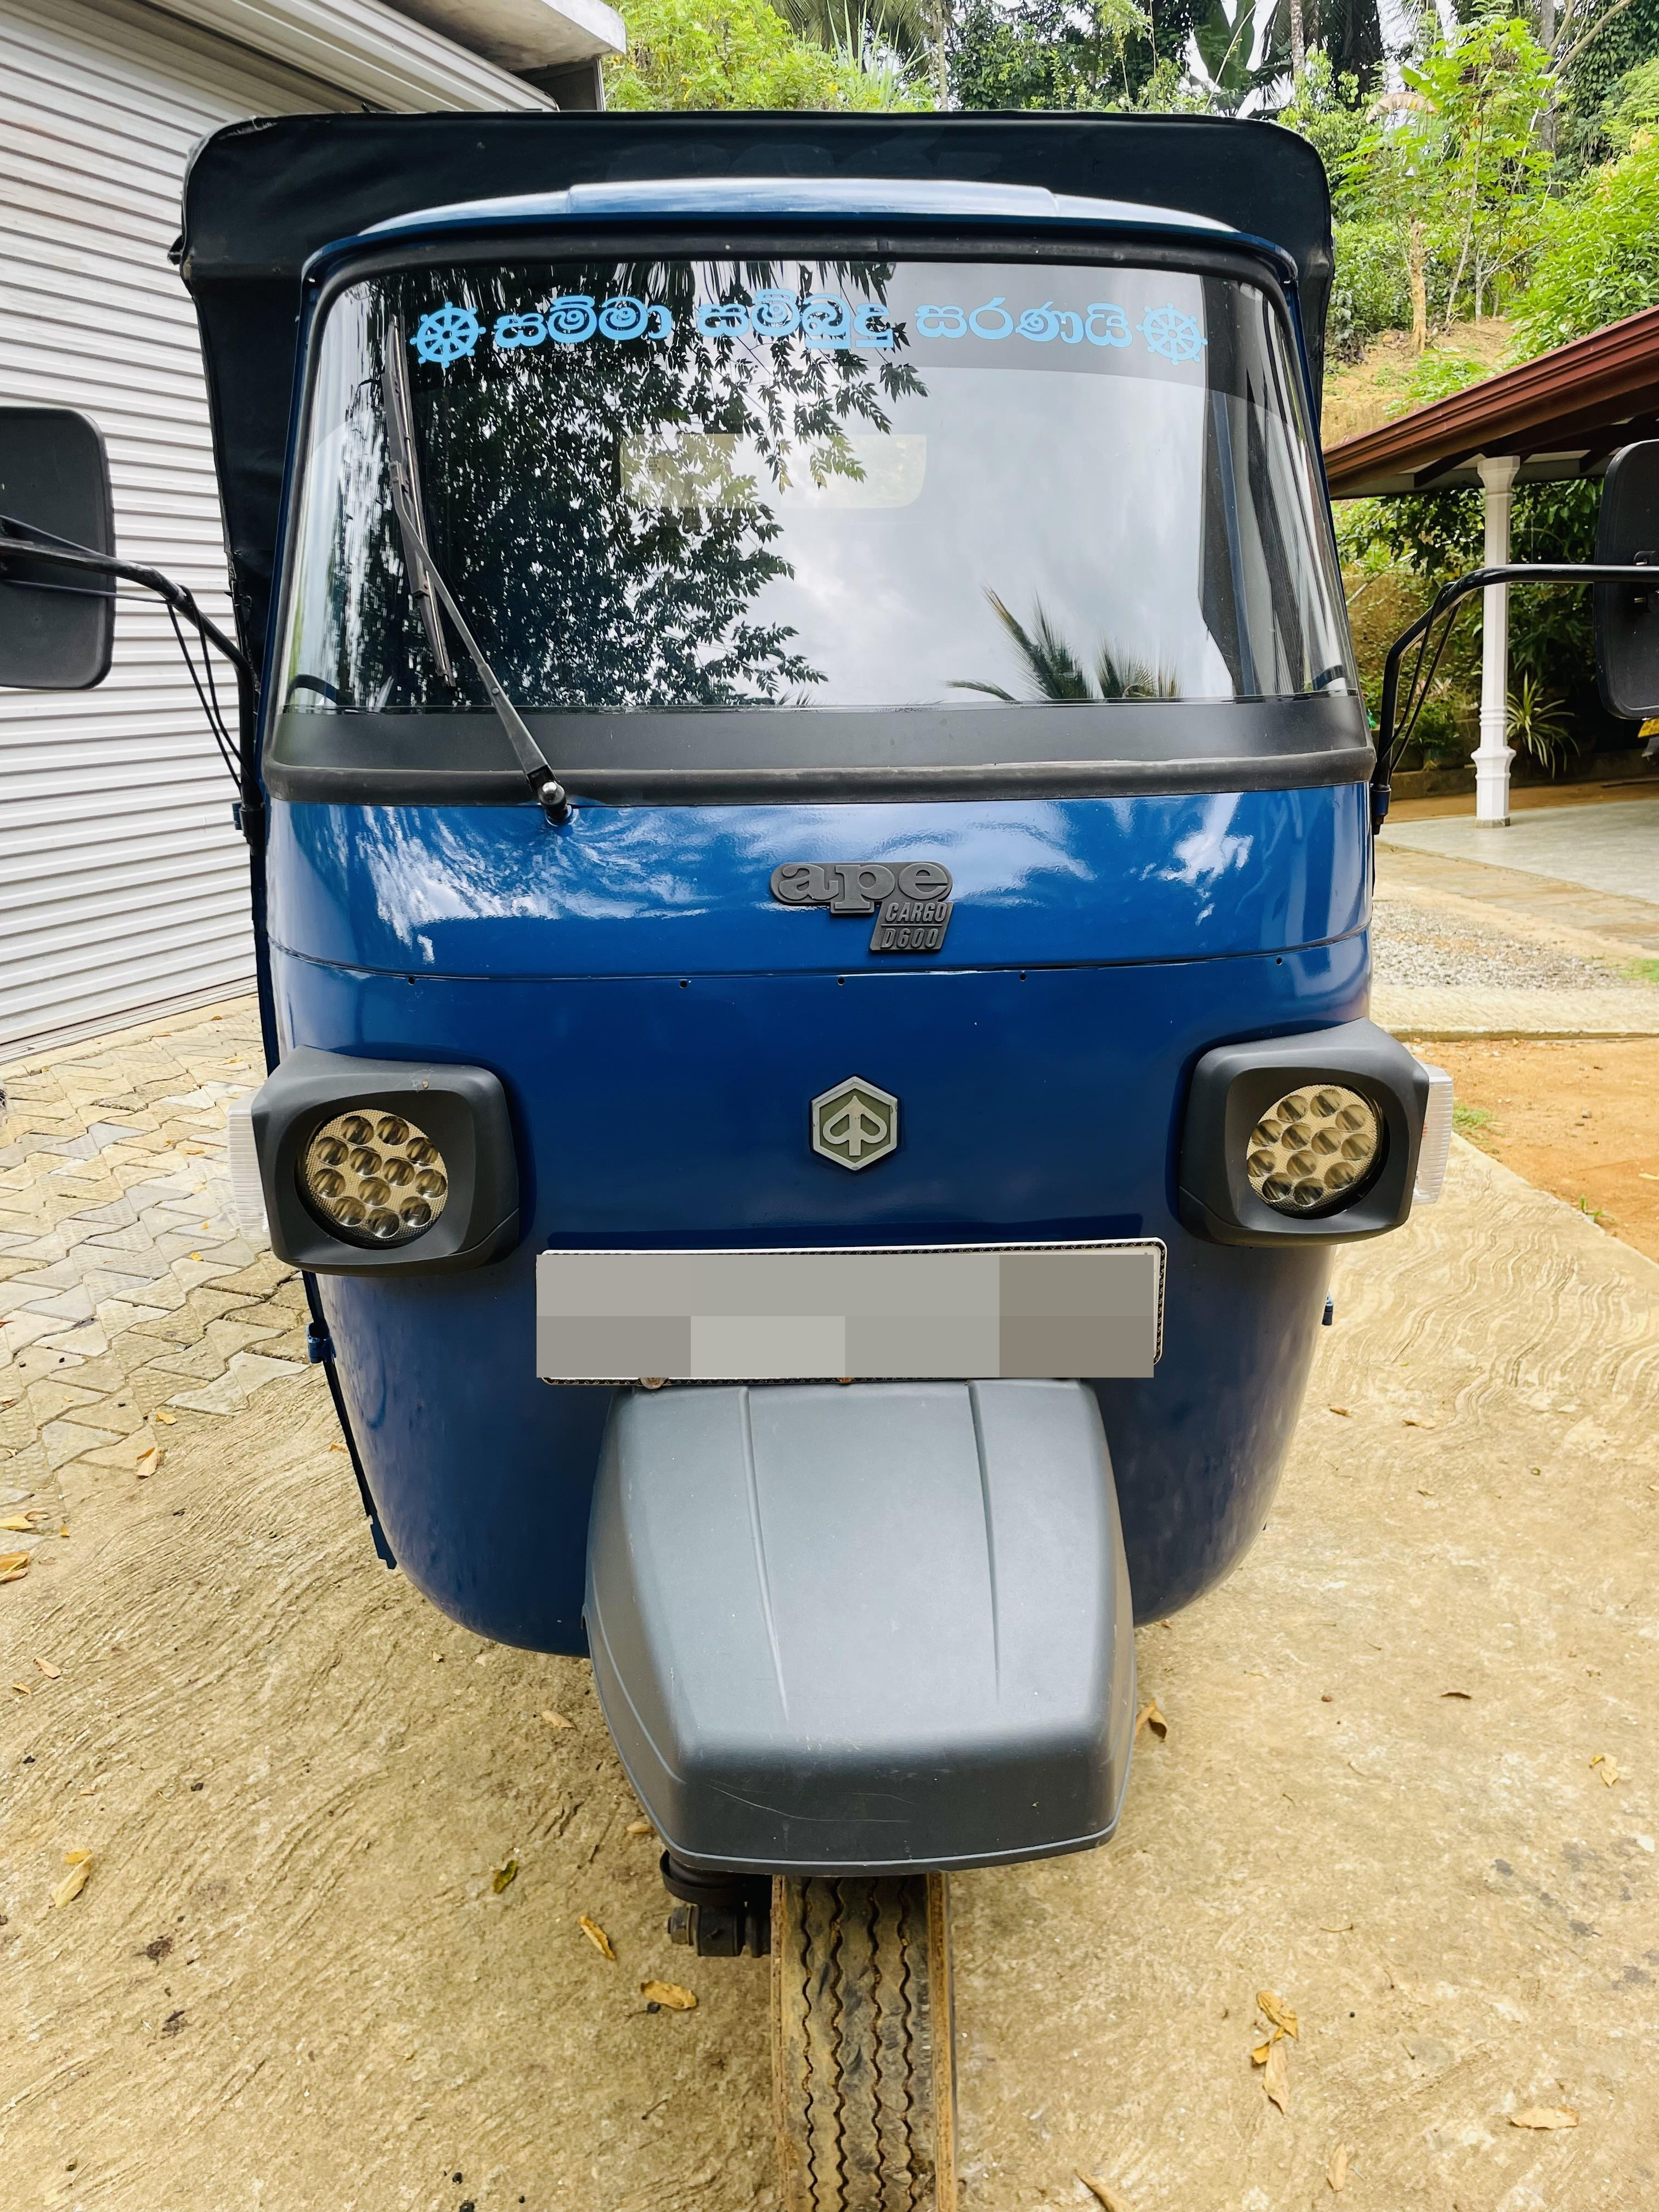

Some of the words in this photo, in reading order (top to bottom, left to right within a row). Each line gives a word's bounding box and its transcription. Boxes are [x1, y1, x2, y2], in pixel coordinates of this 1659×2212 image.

[494, 295, 672, 348] සම්මා
[697, 289, 894, 348] සම්බුදු
[915, 297, 1133, 348] සරණයි
[779, 862, 949, 910] ape
[885, 902, 948, 922] CARGO
[880, 928, 939, 949] D600
